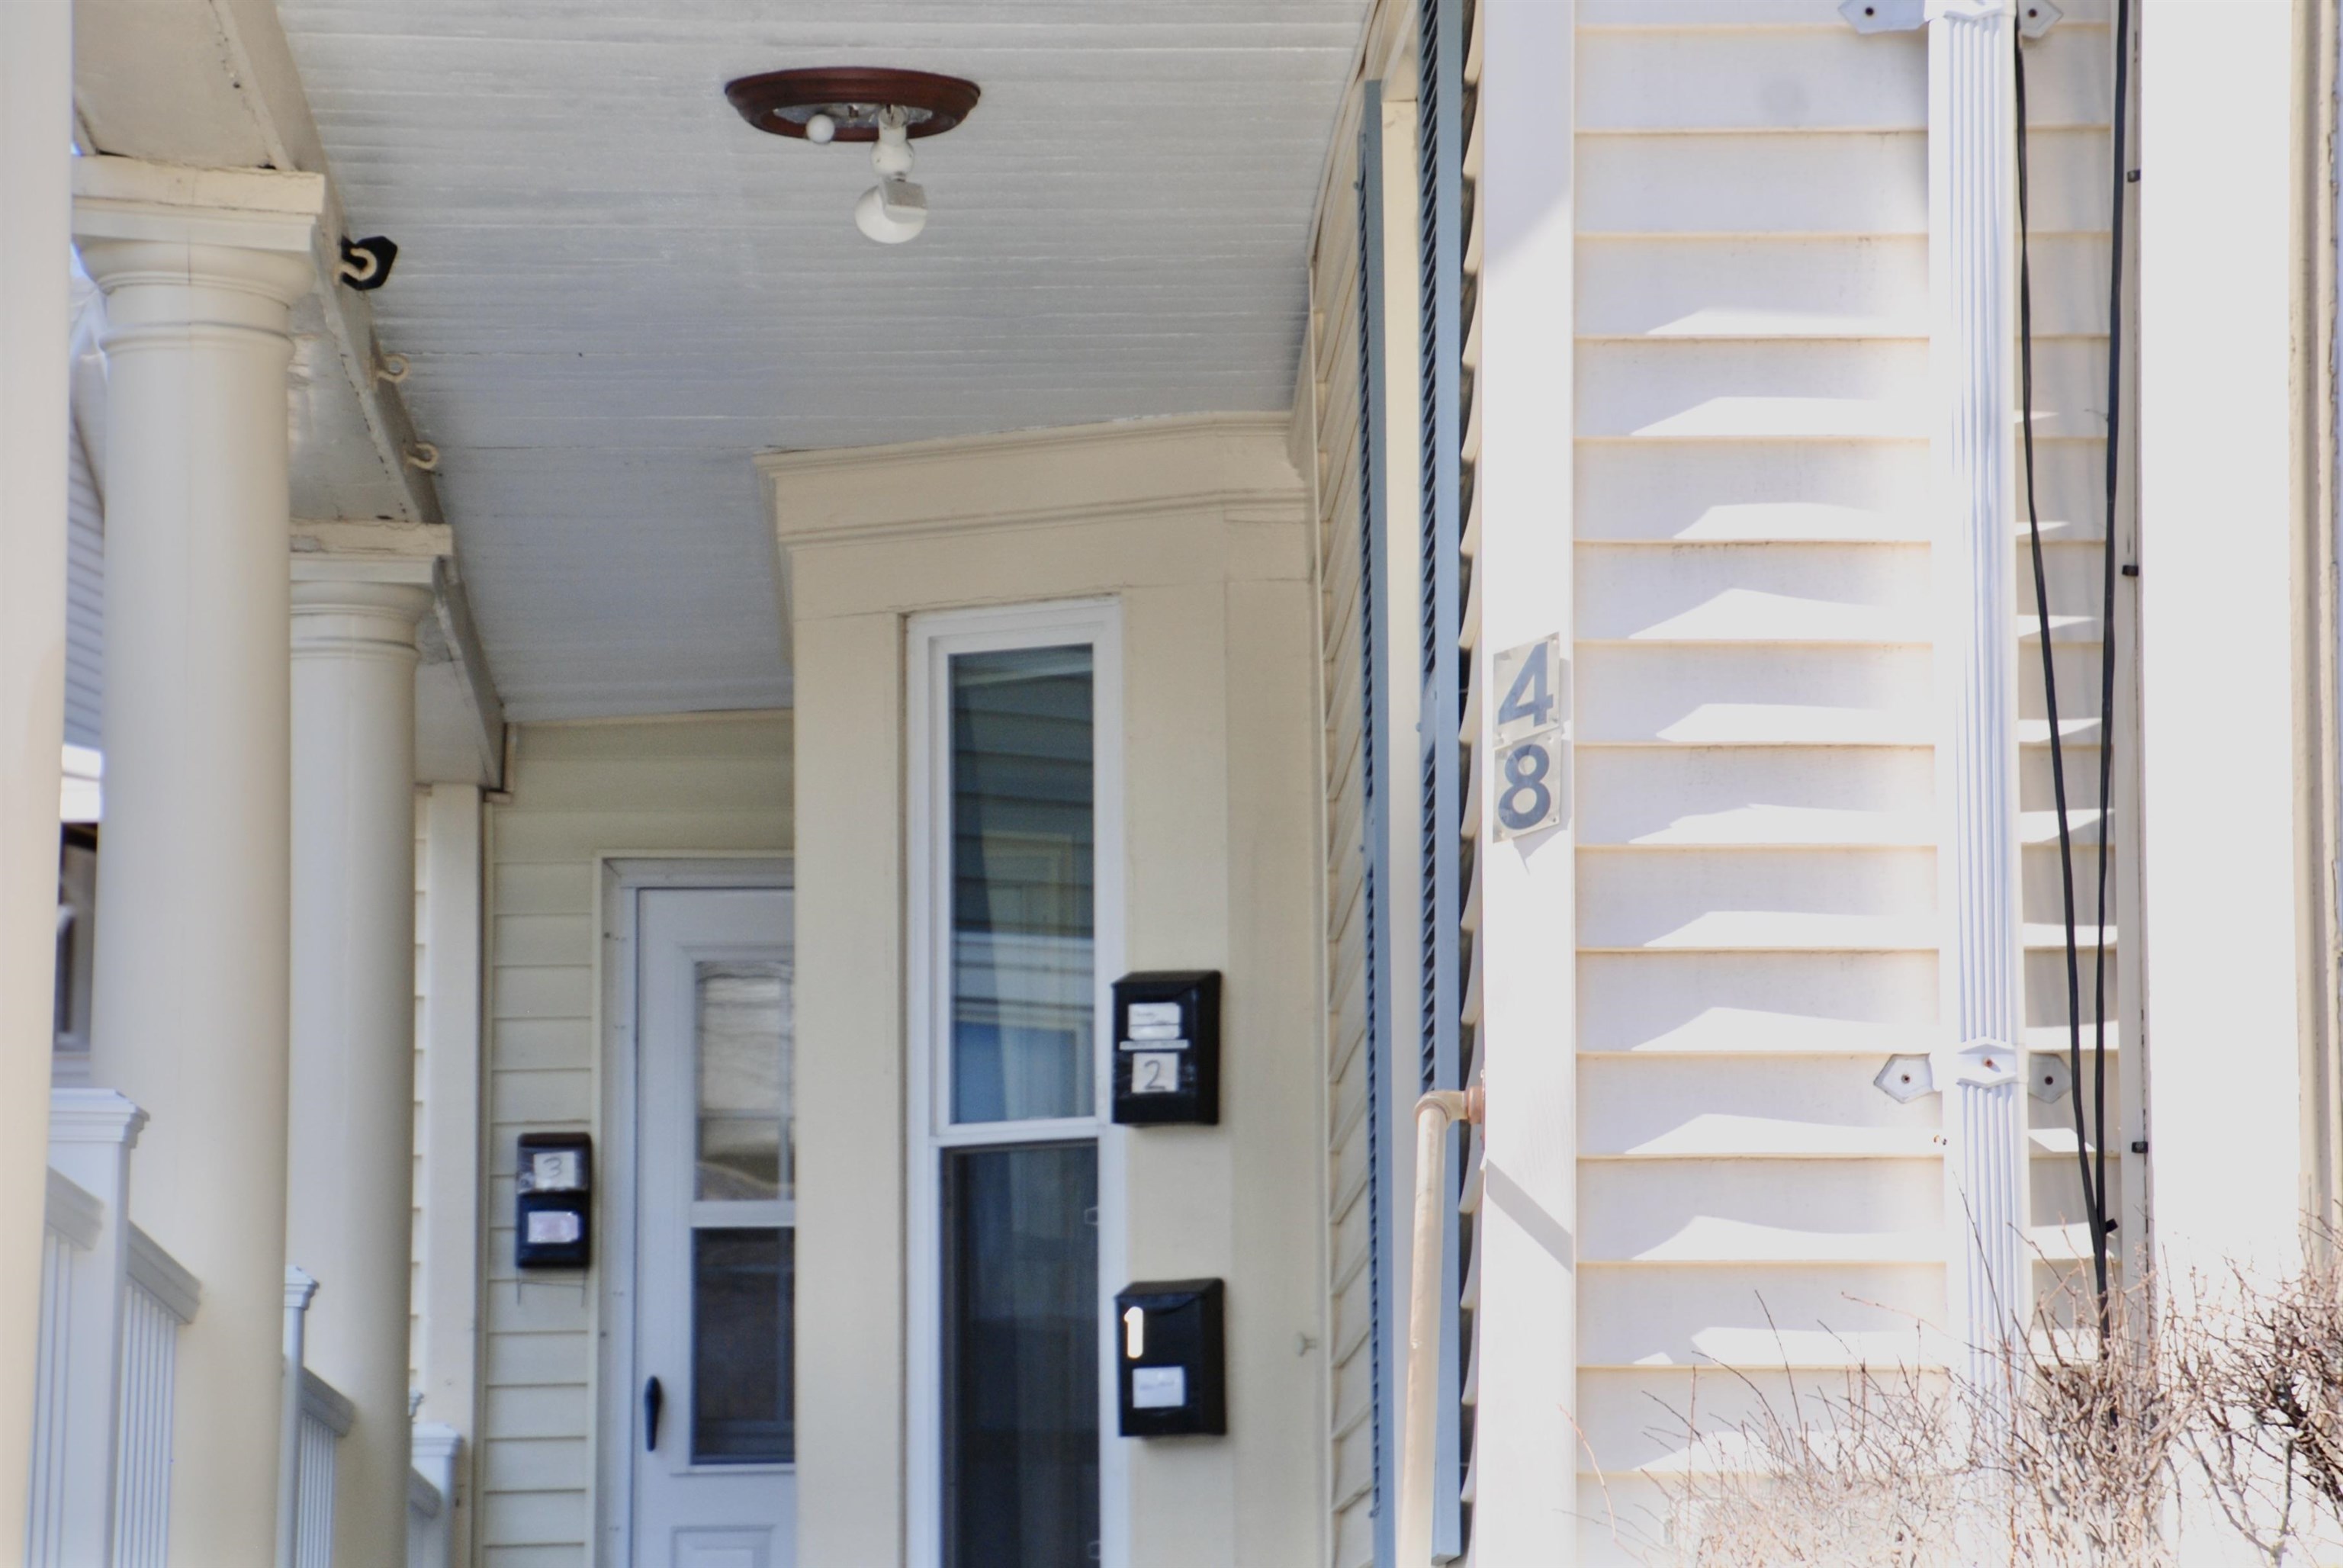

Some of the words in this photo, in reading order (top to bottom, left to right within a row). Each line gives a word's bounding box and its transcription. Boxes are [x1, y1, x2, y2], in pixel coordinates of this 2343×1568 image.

[1144, 1059, 1166, 1091] 2
[542, 1156, 563, 1178] 3
[1123, 1306, 1144, 1359] 1
